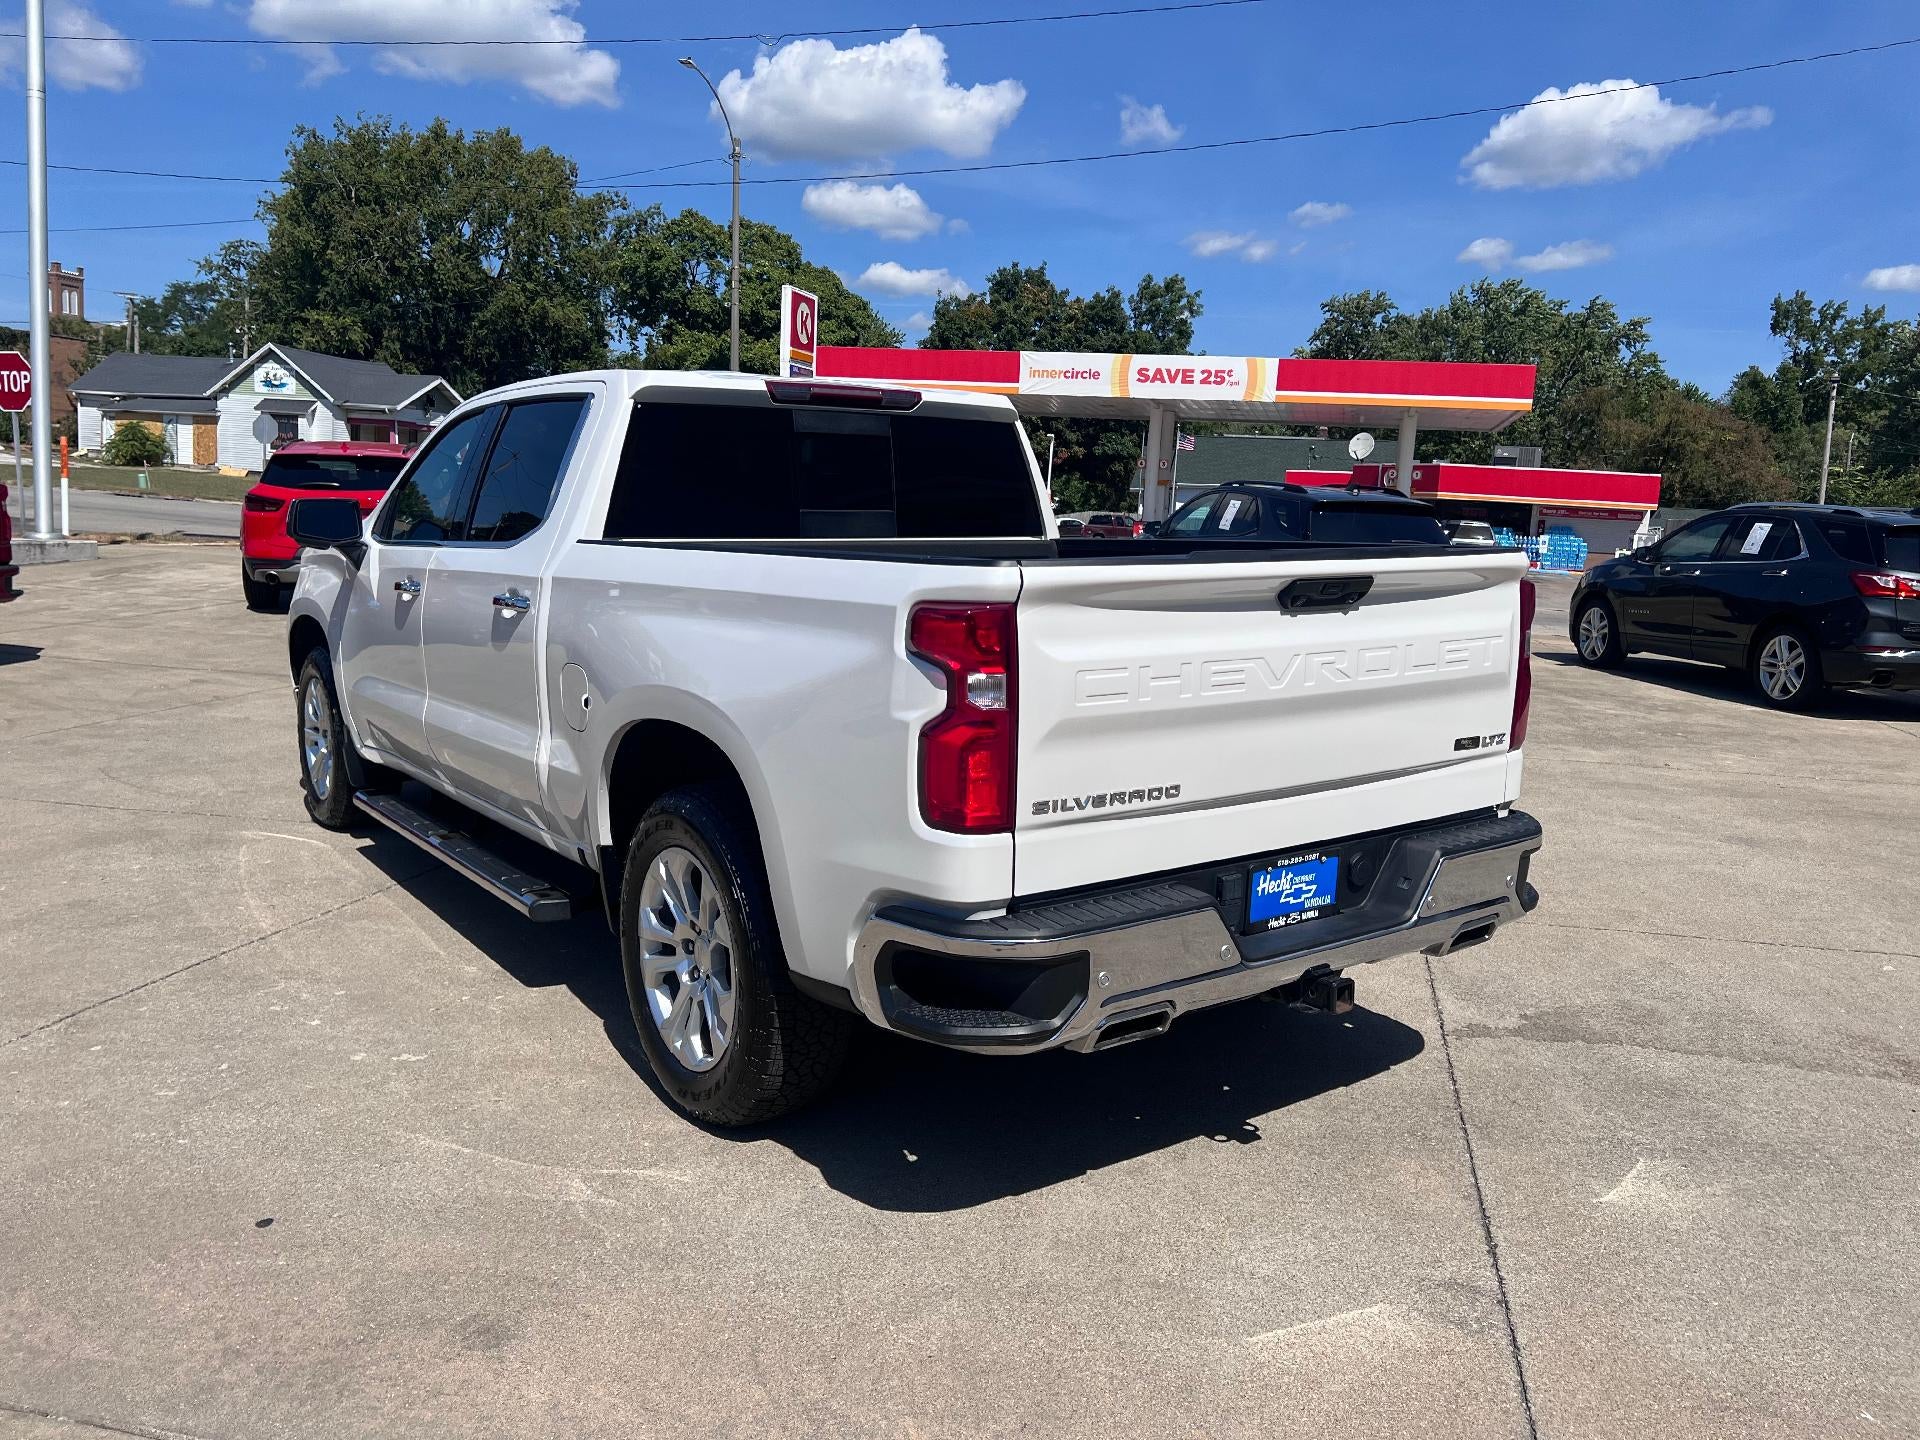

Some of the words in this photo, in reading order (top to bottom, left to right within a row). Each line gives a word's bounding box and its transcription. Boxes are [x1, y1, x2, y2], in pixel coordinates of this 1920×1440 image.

[800, 311, 810, 341] K
[0, 371, 31, 392] TOP
[1029, 367, 1101, 380] innercircle
[1136, 367, 1195, 385] SAVE
[1075, 635, 1504, 706] CHEVROLET
[1481, 733, 1506, 748] LTZ
[1031, 784, 1181, 815] SILVERADO
[1257, 869, 1293, 896] Hecht
